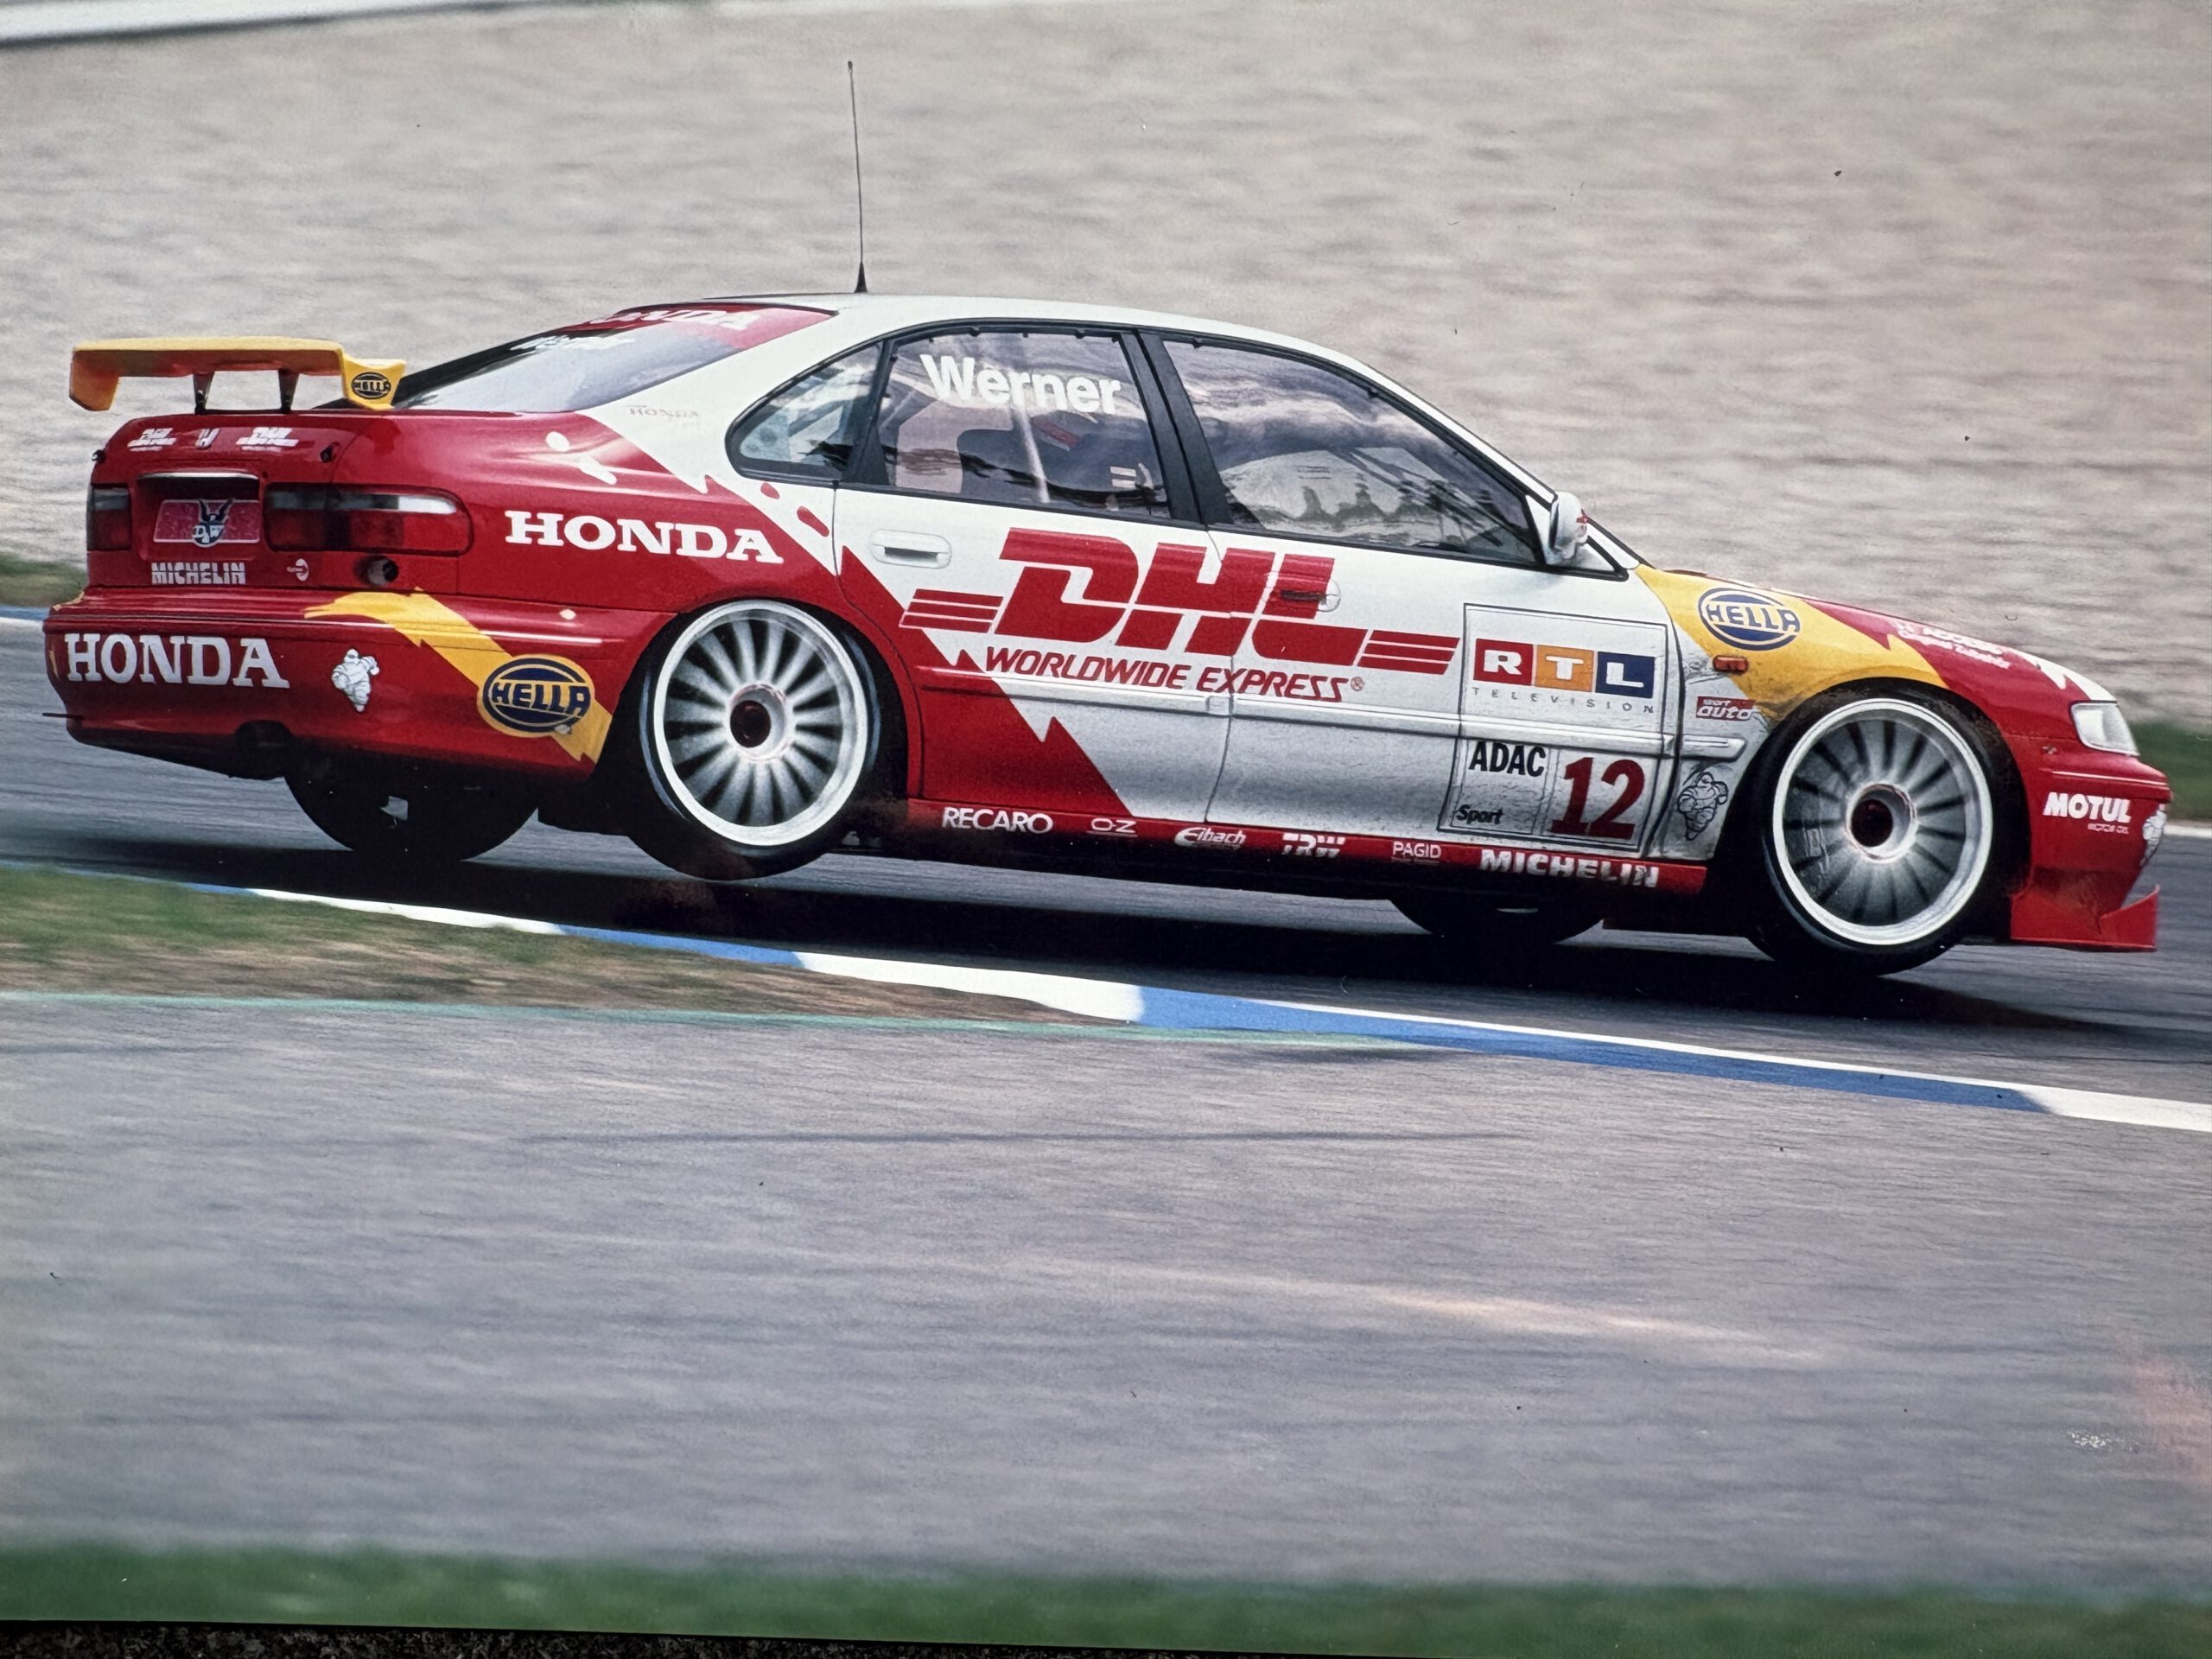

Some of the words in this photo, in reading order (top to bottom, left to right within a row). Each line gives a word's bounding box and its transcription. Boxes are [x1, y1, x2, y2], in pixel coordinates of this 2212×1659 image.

[919, 353, 1122, 415] Werner
[505, 510, 785, 564] HONDA
[151, 562, 246, 585] MICHELIN
[995, 527, 1369, 666] DHL
[1706, 604, 1801, 632] HELLA
[64, 632, 290, 690] HONDA
[985, 645, 1191, 691] WORLDWIDE
[1196, 665, 1350, 702] EXPRESS
[1483, 649, 1644, 688] RTL
[492, 681, 591, 717] HELLA
[1471, 687, 1654, 714] TELEVISION
[1696, 706, 1752, 720] auto
[1468, 741, 1547, 778] ADAC
[1455, 804, 1503, 826] Sport
[1551, 757, 1645, 841] 12
[2043, 791, 2132, 823] MOTUL
[942, 806, 1054, 834] RECARO
[1173, 827, 1247, 848] Eibach
[1282, 832, 1345, 858] TRW
[1392, 841, 1442, 859] PAGID
[1478, 848, 1660, 889] MICHELIN
